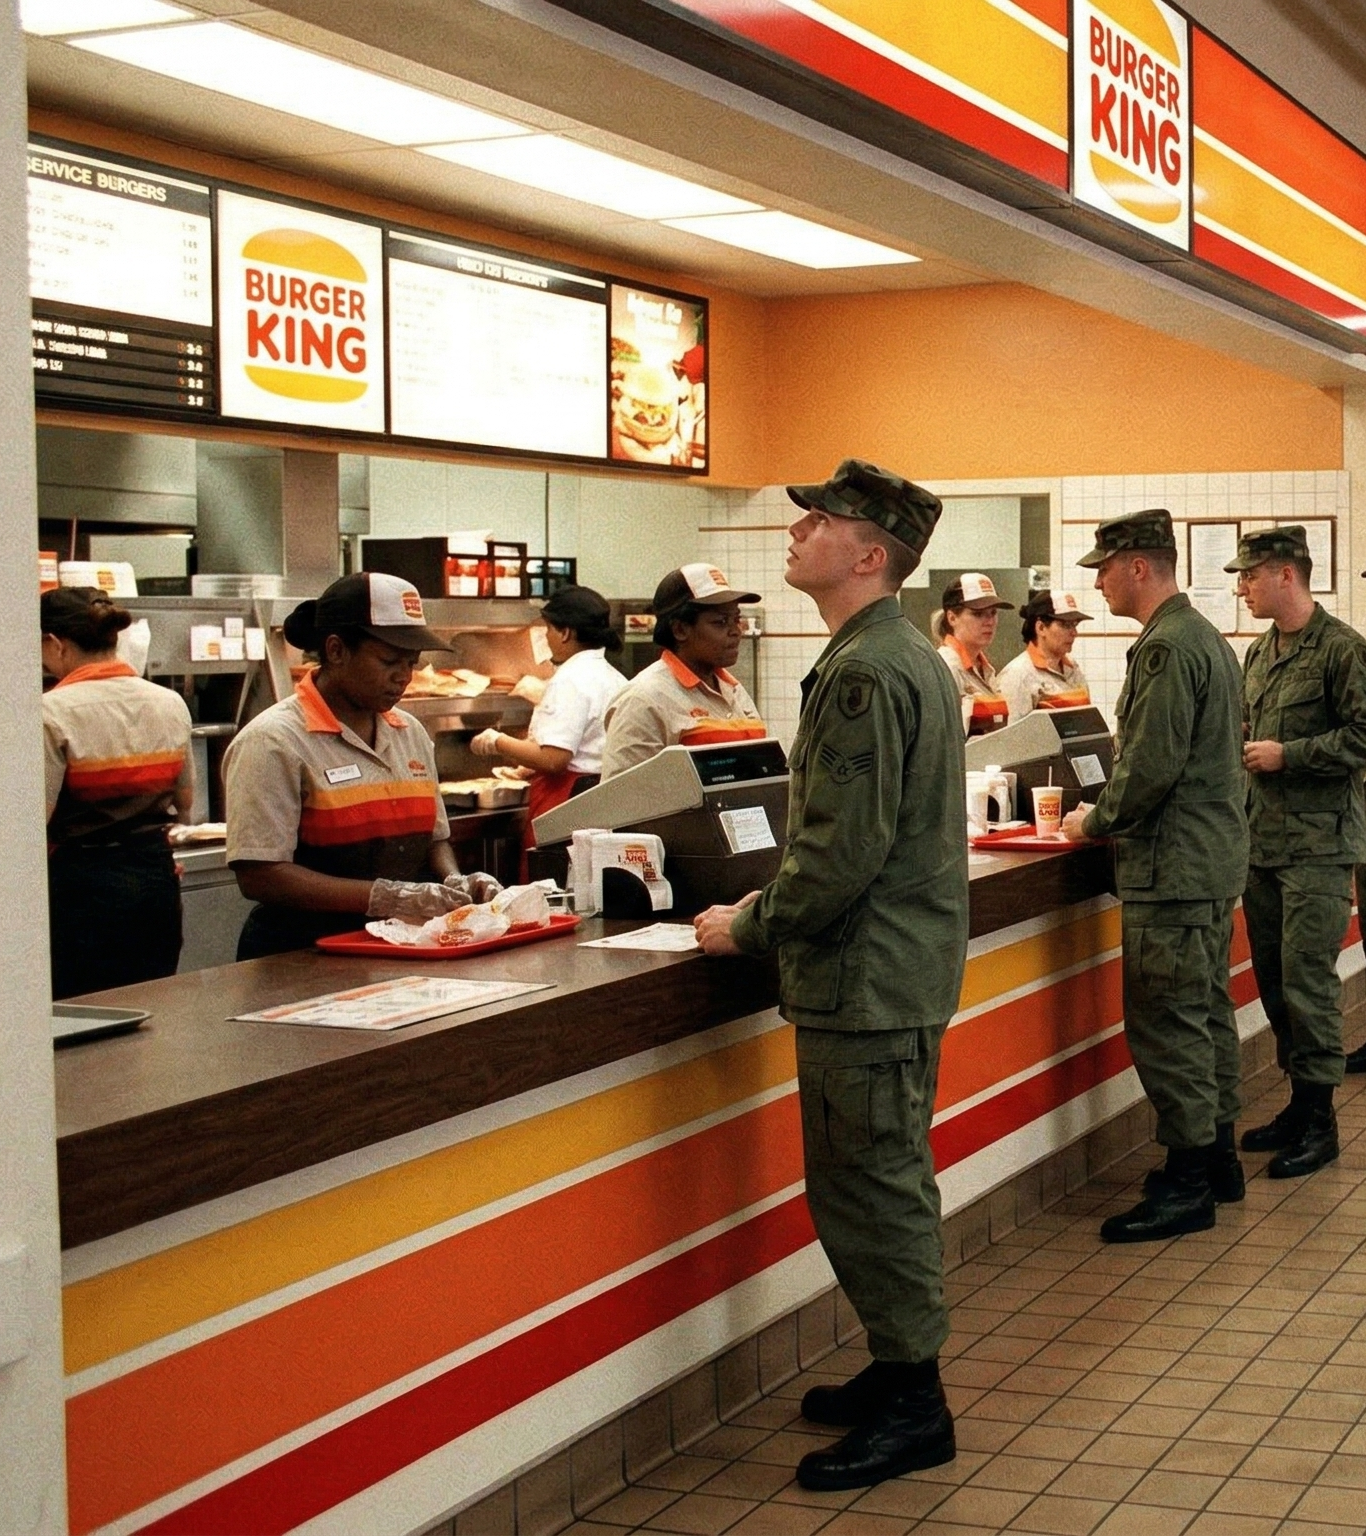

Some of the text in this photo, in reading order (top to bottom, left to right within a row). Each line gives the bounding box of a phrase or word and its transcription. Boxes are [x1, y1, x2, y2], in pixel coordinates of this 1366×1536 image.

[1090, 15, 1180, 118] BURGER
[1091, 73, 1181, 186] KING
[246, 268, 366, 322] BURGER
[247, 309, 366, 373] KING
